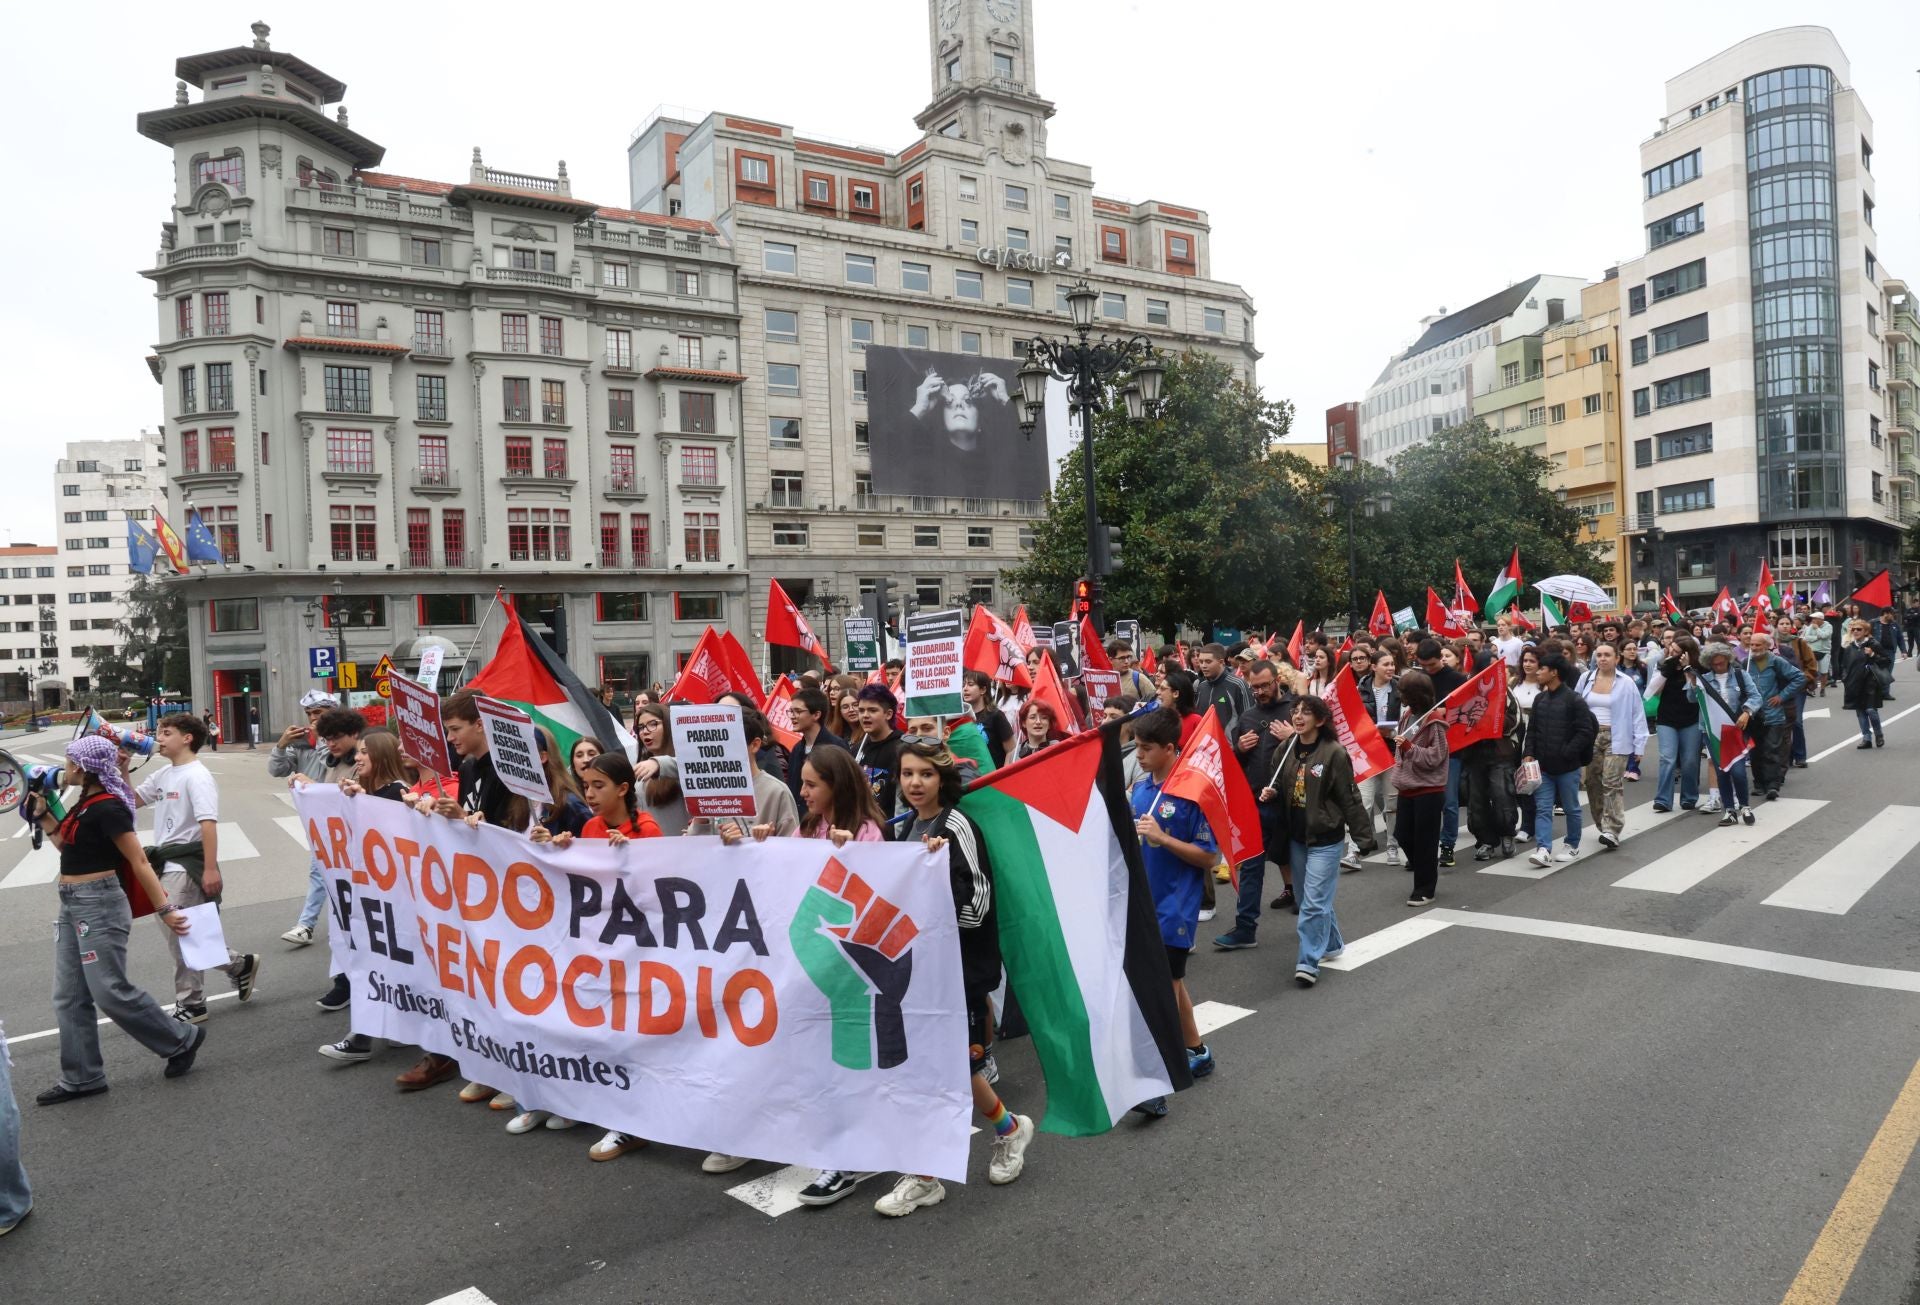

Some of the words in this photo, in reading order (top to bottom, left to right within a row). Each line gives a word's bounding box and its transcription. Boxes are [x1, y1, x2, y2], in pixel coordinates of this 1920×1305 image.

[911, 641, 955, 656] SOLIDARIDAD
[316, 649, 329, 666] P
[909, 653, 959, 668] INTERNACIONAL
[911, 669, 924, 680] CON
[924, 668, 933, 678] LA
[934, 665, 956, 676] CAUSA
[916, 678, 950, 690] PALESTINA
[1094, 684, 1107, 697] NO
[406, 695, 422, 717] NO
[1089, 696, 1106, 710] PAS
[396, 704, 440, 740] PASARÁ
[701, 714, 725, 724] GENERAL
[726, 713, 735, 722] YA!
[492, 719, 522, 738] ISRAEL
[687, 728, 729, 742] PARARLO
[493, 733, 530, 754] ASESINA
[498, 748, 532, 768] EUROPA
[697, 745, 724, 758] TODO
[496, 761, 544, 785] PATROCINA
[684, 762, 710, 774] PARA
[710, 760, 743, 774] PARAR
[685, 778, 696, 790] EL
[697, 776, 747, 789] GENOCIDIO
[733, 798, 742, 806] de
[394, 836, 555, 931] TODO
[566, 873, 770, 957] PARA
[360, 897, 414, 965] EL
[462, 1017, 631, 1091] Estudiantes
